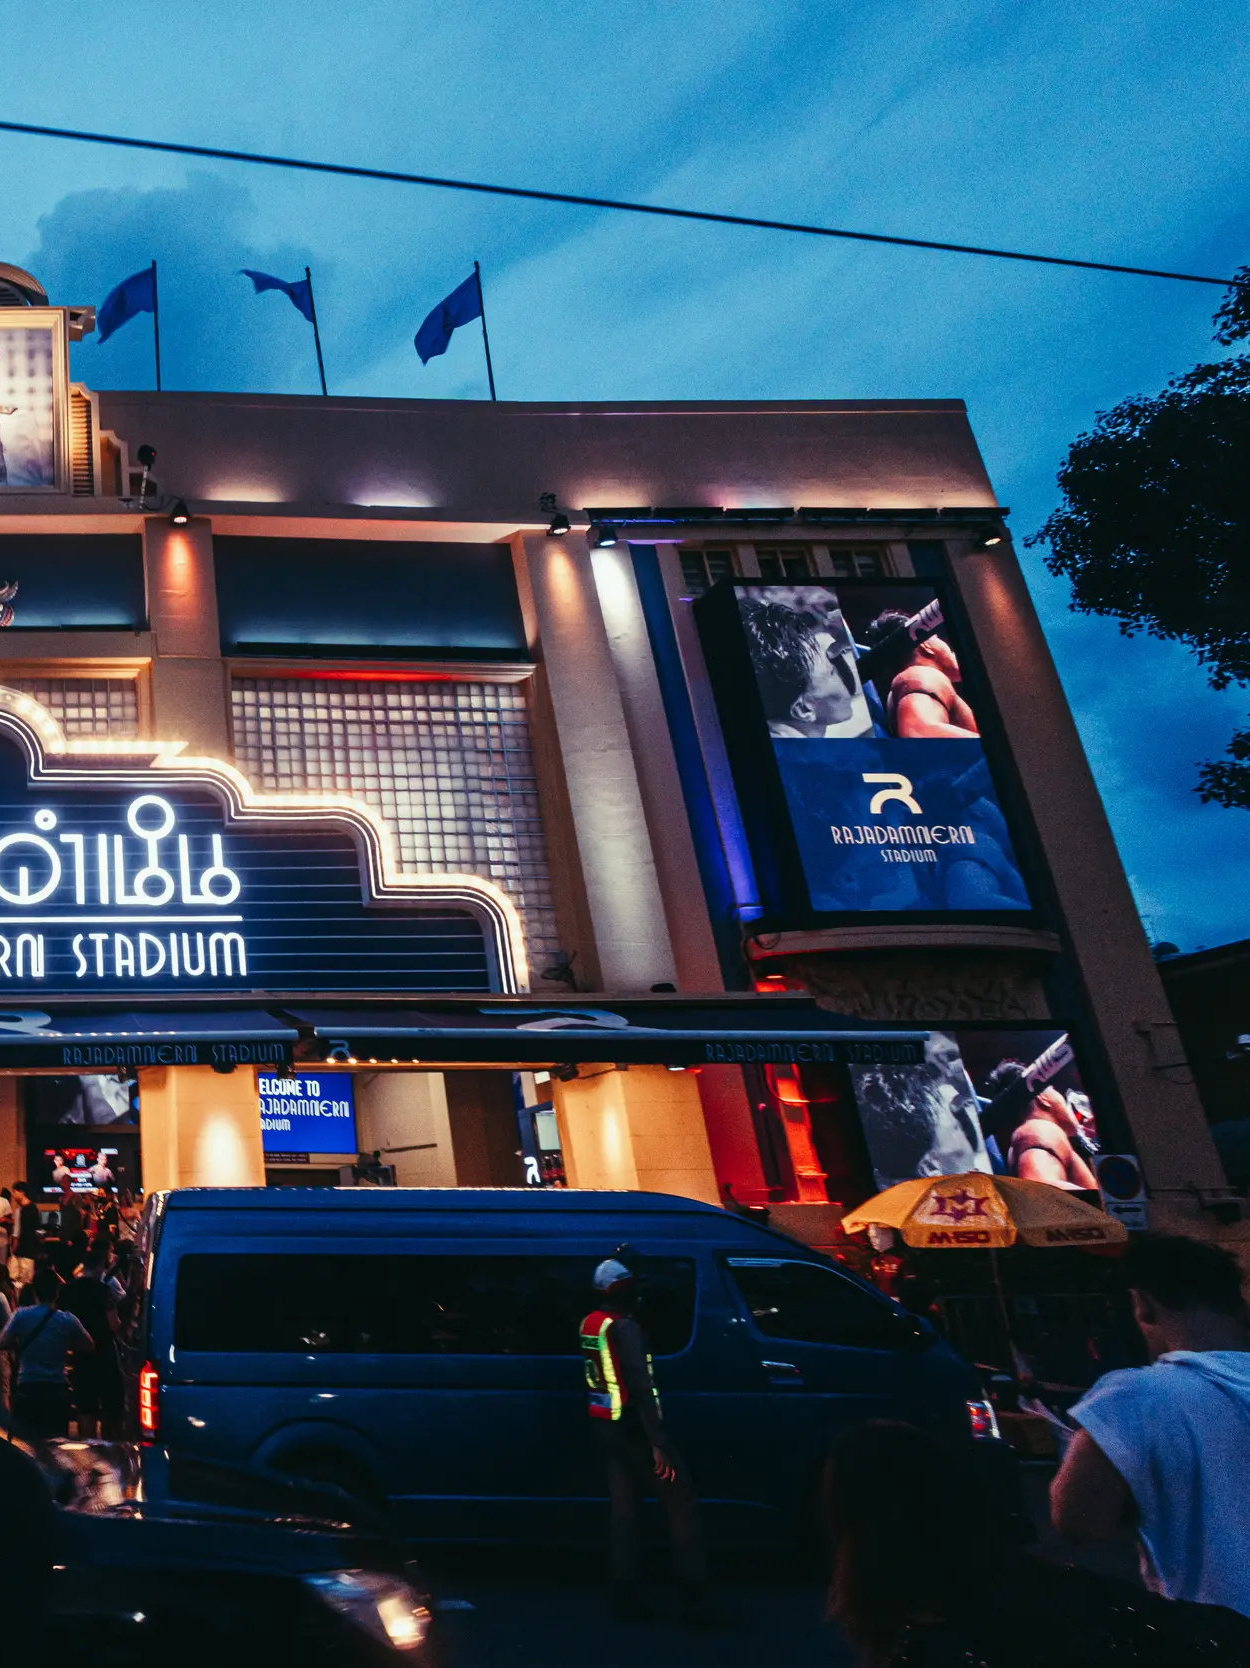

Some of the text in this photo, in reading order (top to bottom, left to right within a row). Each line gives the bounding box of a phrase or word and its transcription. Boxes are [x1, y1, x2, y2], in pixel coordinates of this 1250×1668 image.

[830, 826, 975, 845] RAJADAMNERN
[880, 849, 938, 863] STADIUM
[72, 931, 248, 977] STADIUM
[62, 1043, 286, 1066] RAJADAMNERN STADIUM
[704, 1042, 918, 1062] RAJADAMNERN STADIUM
[258, 1078, 320, 1097] ELCOME TO
[259, 1098, 350, 1118] AJADAMNERN
[260, 1118, 291, 1131] ADIUM
